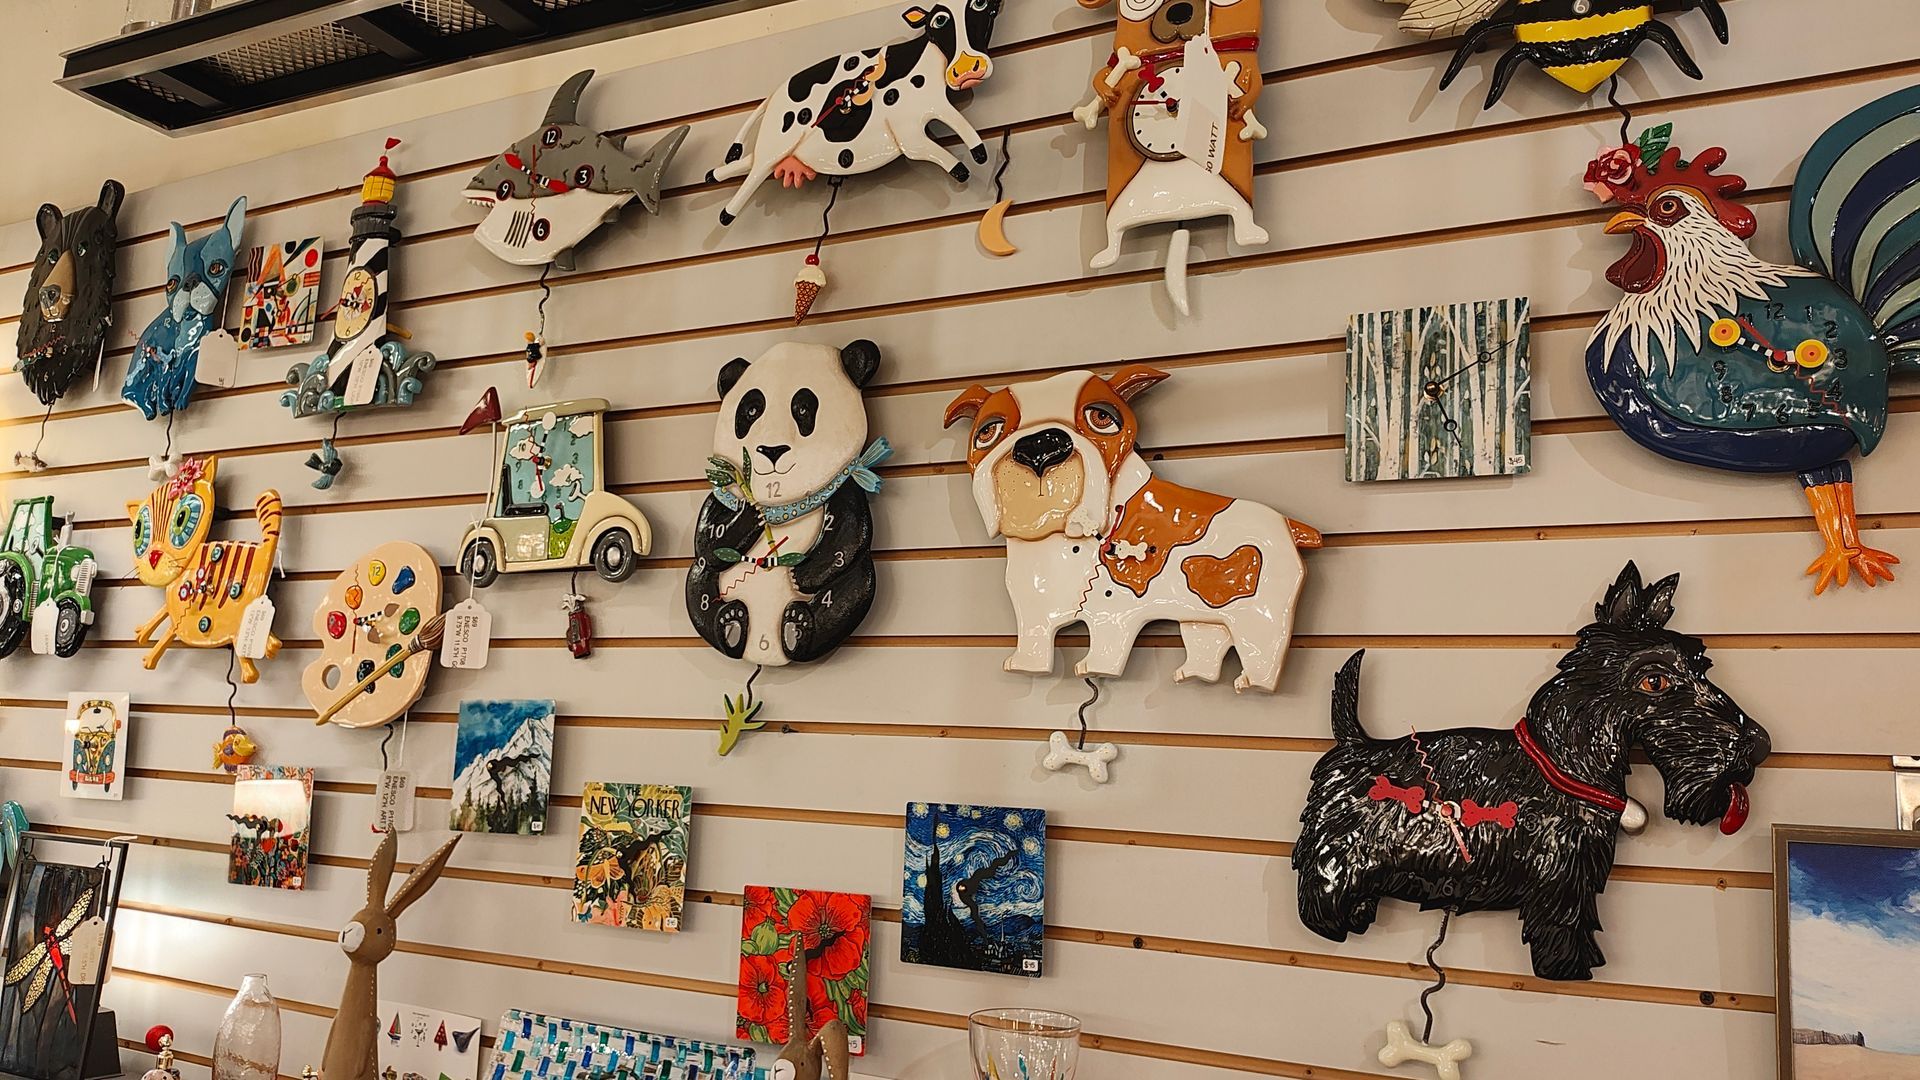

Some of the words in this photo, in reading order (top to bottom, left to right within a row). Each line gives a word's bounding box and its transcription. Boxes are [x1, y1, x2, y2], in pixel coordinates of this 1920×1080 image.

[1574, 0, 1585, 13] 6
[801, 110, 809, 122] 9
[546, 130, 557, 144] 12
[1208, 121, 1218, 158] WATT
[580, 170, 588, 184] 3
[501, 183, 509, 198] 9
[537, 219, 545, 236] 6
[354, 272, 362, 281] 12
[1764, 303, 1785, 320] 12
[1804, 305, 1814, 321] 1
[345, 327, 351, 337] 6
[1824, 321, 1838, 339] 2
[1833, 347, 1848, 369] 3
[1713, 360, 1727, 380] 9
[1720, 385, 1733, 403] 8
[1824, 378, 1842, 400] 4
[1741, 402, 1757, 422] 7
[1775, 403, 1790, 423] 6
[518, 443, 527, 452] 10
[572, 452, 579, 464] 3
[515, 462, 522, 473] 9
[517, 480, 524, 490] 8
[765, 482, 782, 498] 12
[824, 514, 835, 531] 2
[708, 523, 725, 539] 10
[213, 547, 221, 559] 2
[834, 551, 845, 568] 3
[372, 566, 381, 576] 12
[699, 557, 706, 574] 9
[232, 585, 239, 597] 3
[821, 590, 833, 608] 4
[14, 601, 20, 611] 3
[700, 594, 709, 611] 8
[462, 615, 471, 643] ENESCO
[759, 634, 769, 651] 6
[460, 647, 468, 666] P1708
[389, 775, 399, 806] ENESCO
[626, 786, 641, 796] THE
[589, 795, 622, 816] NEW
[625, 797, 681, 819] YORKER
[1024, 960, 1036, 969] $45
